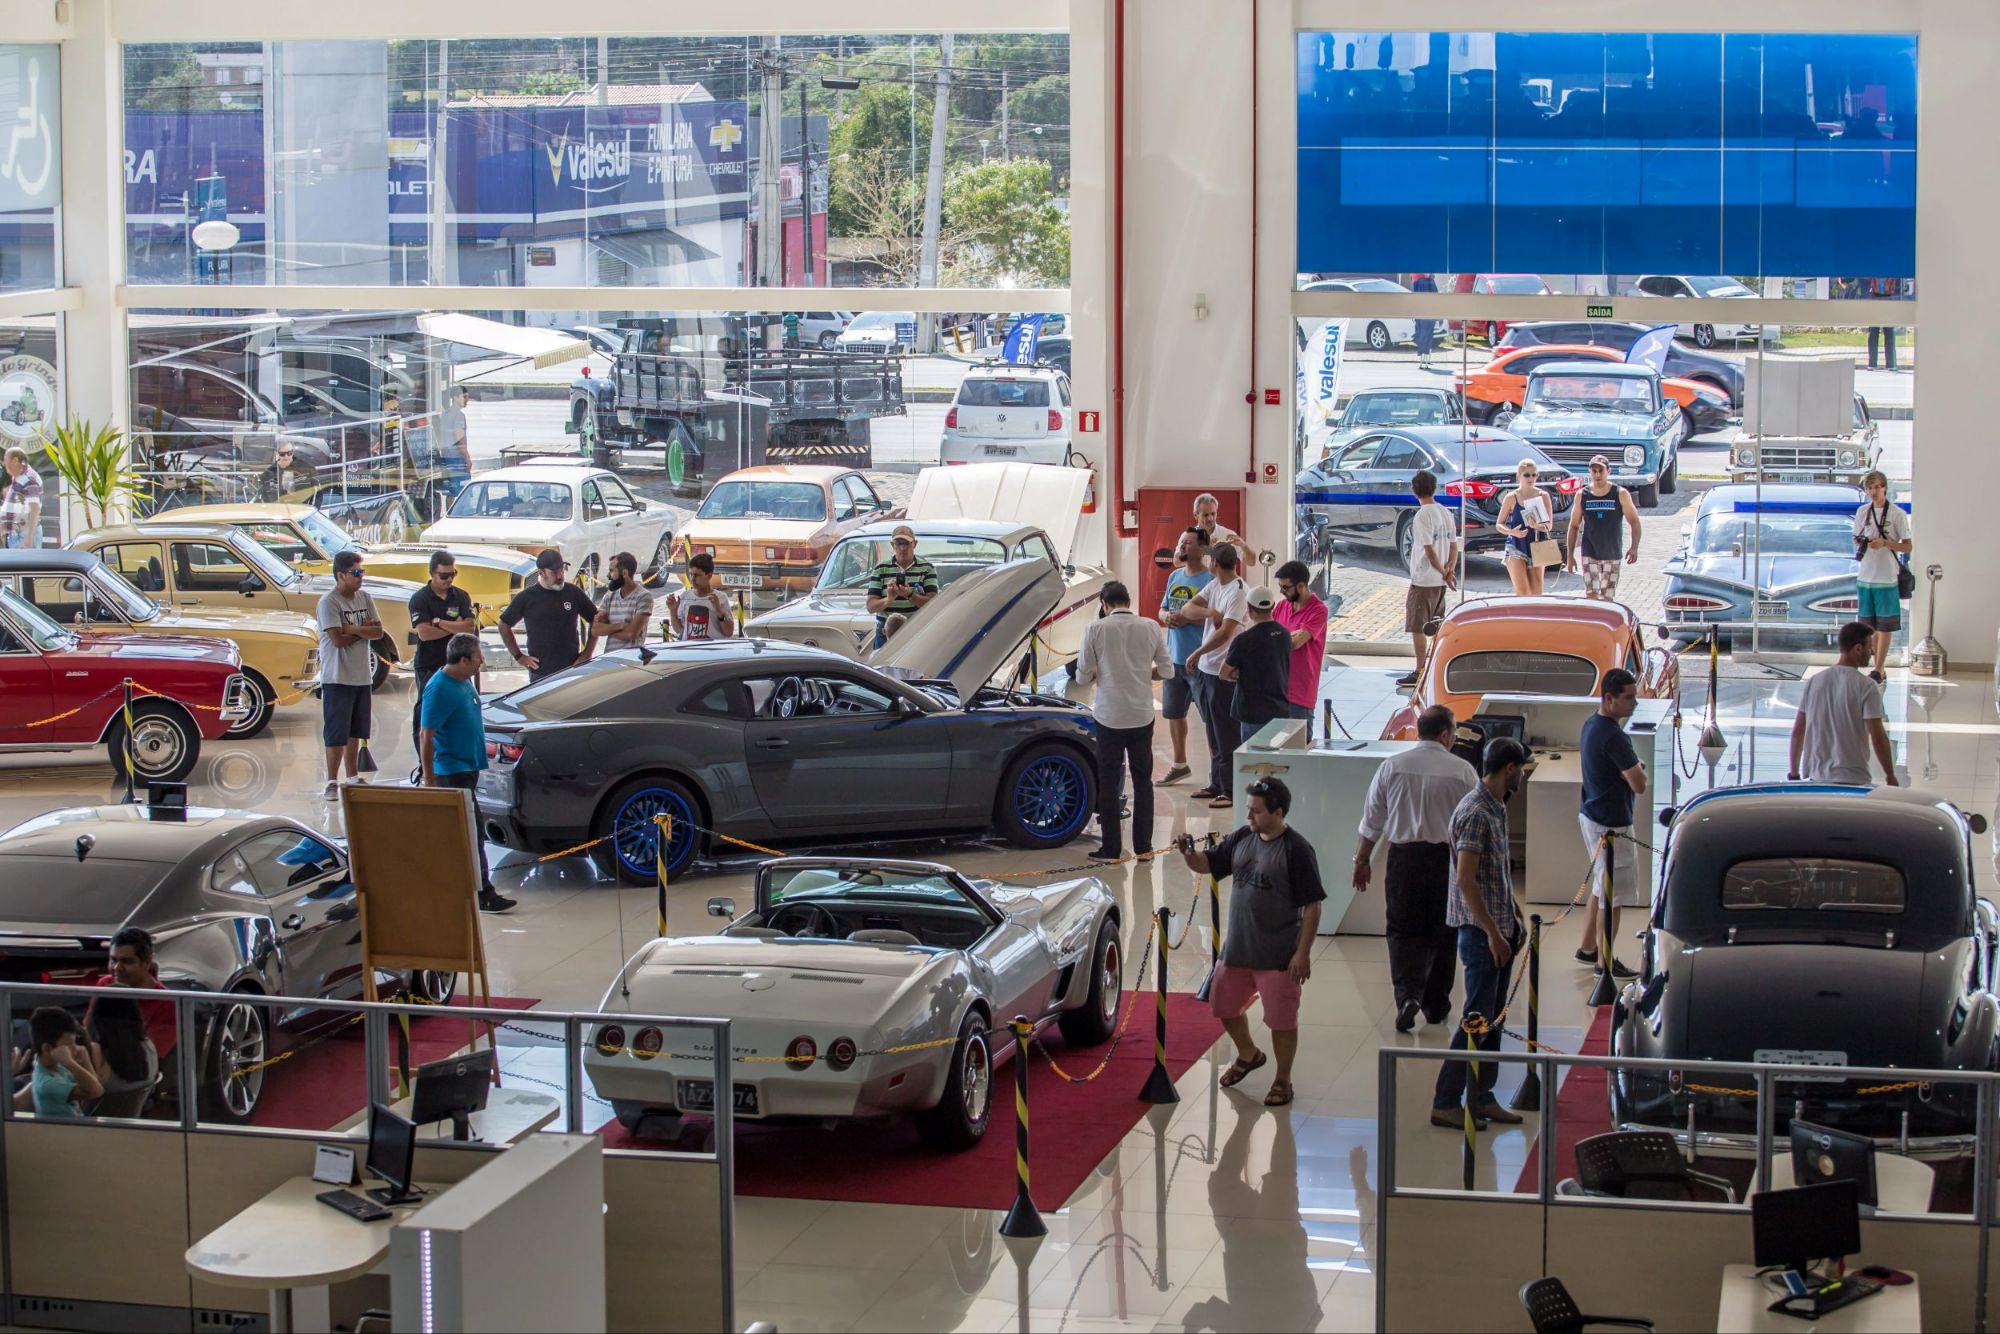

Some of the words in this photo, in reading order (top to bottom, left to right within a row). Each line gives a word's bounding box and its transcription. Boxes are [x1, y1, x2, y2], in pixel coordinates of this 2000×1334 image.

[648, 121, 693, 151] FUNILARIA
[568, 129, 631, 181] valesul
[647, 157, 654, 184] E
[655, 155, 693, 184] PINTURA
[709, 161, 744, 176] CHEVROLET
[1588, 306, 1612, 317] SAÍDA
[1318, 324, 1340, 400] valesul
